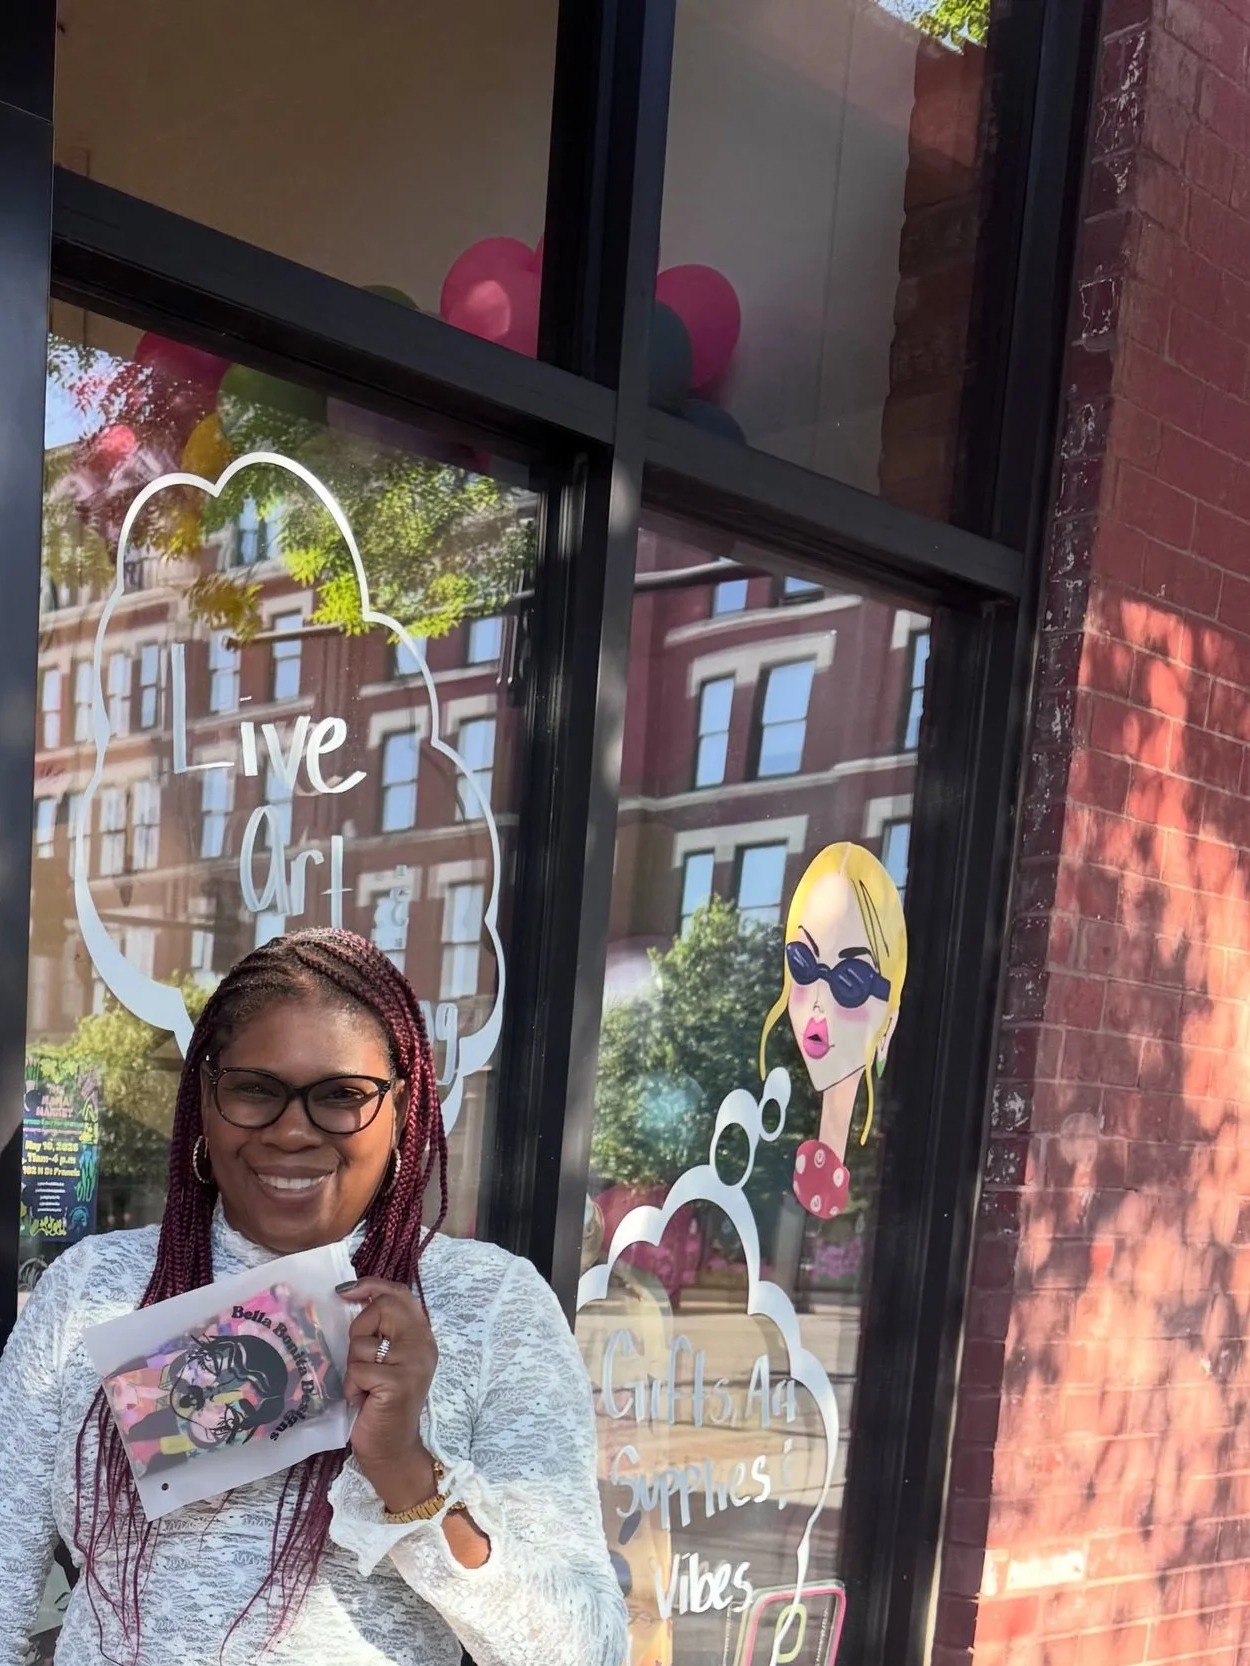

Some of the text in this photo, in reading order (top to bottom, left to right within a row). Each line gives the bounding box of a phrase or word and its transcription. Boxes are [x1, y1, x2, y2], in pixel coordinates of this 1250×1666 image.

[171, 643, 367, 798] Live
[231, 1305, 315, 1441] Bella Bonita Designs
[610, 1444, 772, 1533] Supplies
[652, 1552, 754, 1620] Vibes
